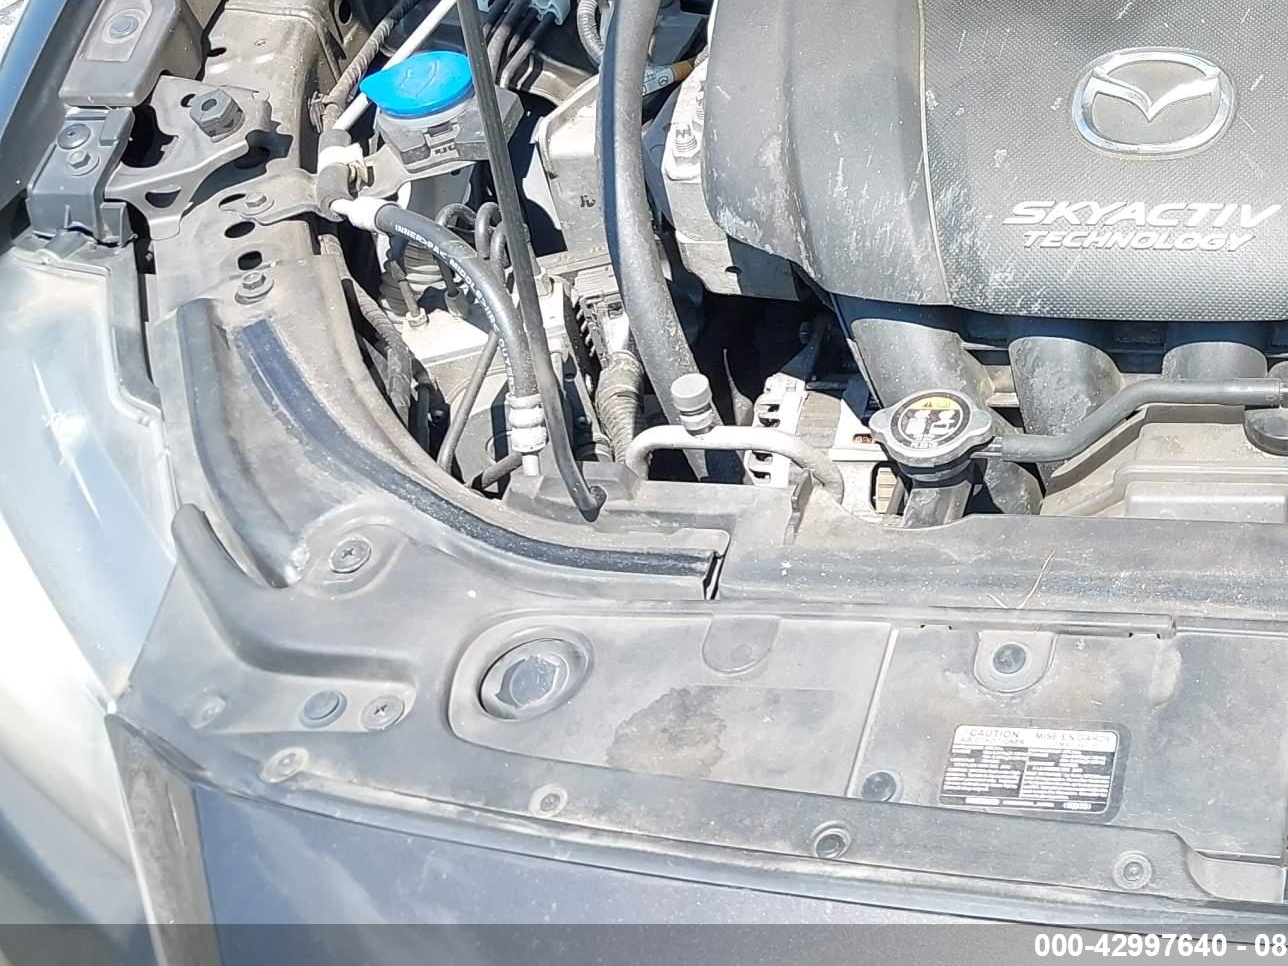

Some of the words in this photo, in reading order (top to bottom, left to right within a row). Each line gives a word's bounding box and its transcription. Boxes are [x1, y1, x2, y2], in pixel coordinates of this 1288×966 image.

[1002, 200, 1282, 229] SKYACTIV
[1022, 229, 1257, 252] TECHNOLOGY
[969, 729, 1020, 738] CAUTION
